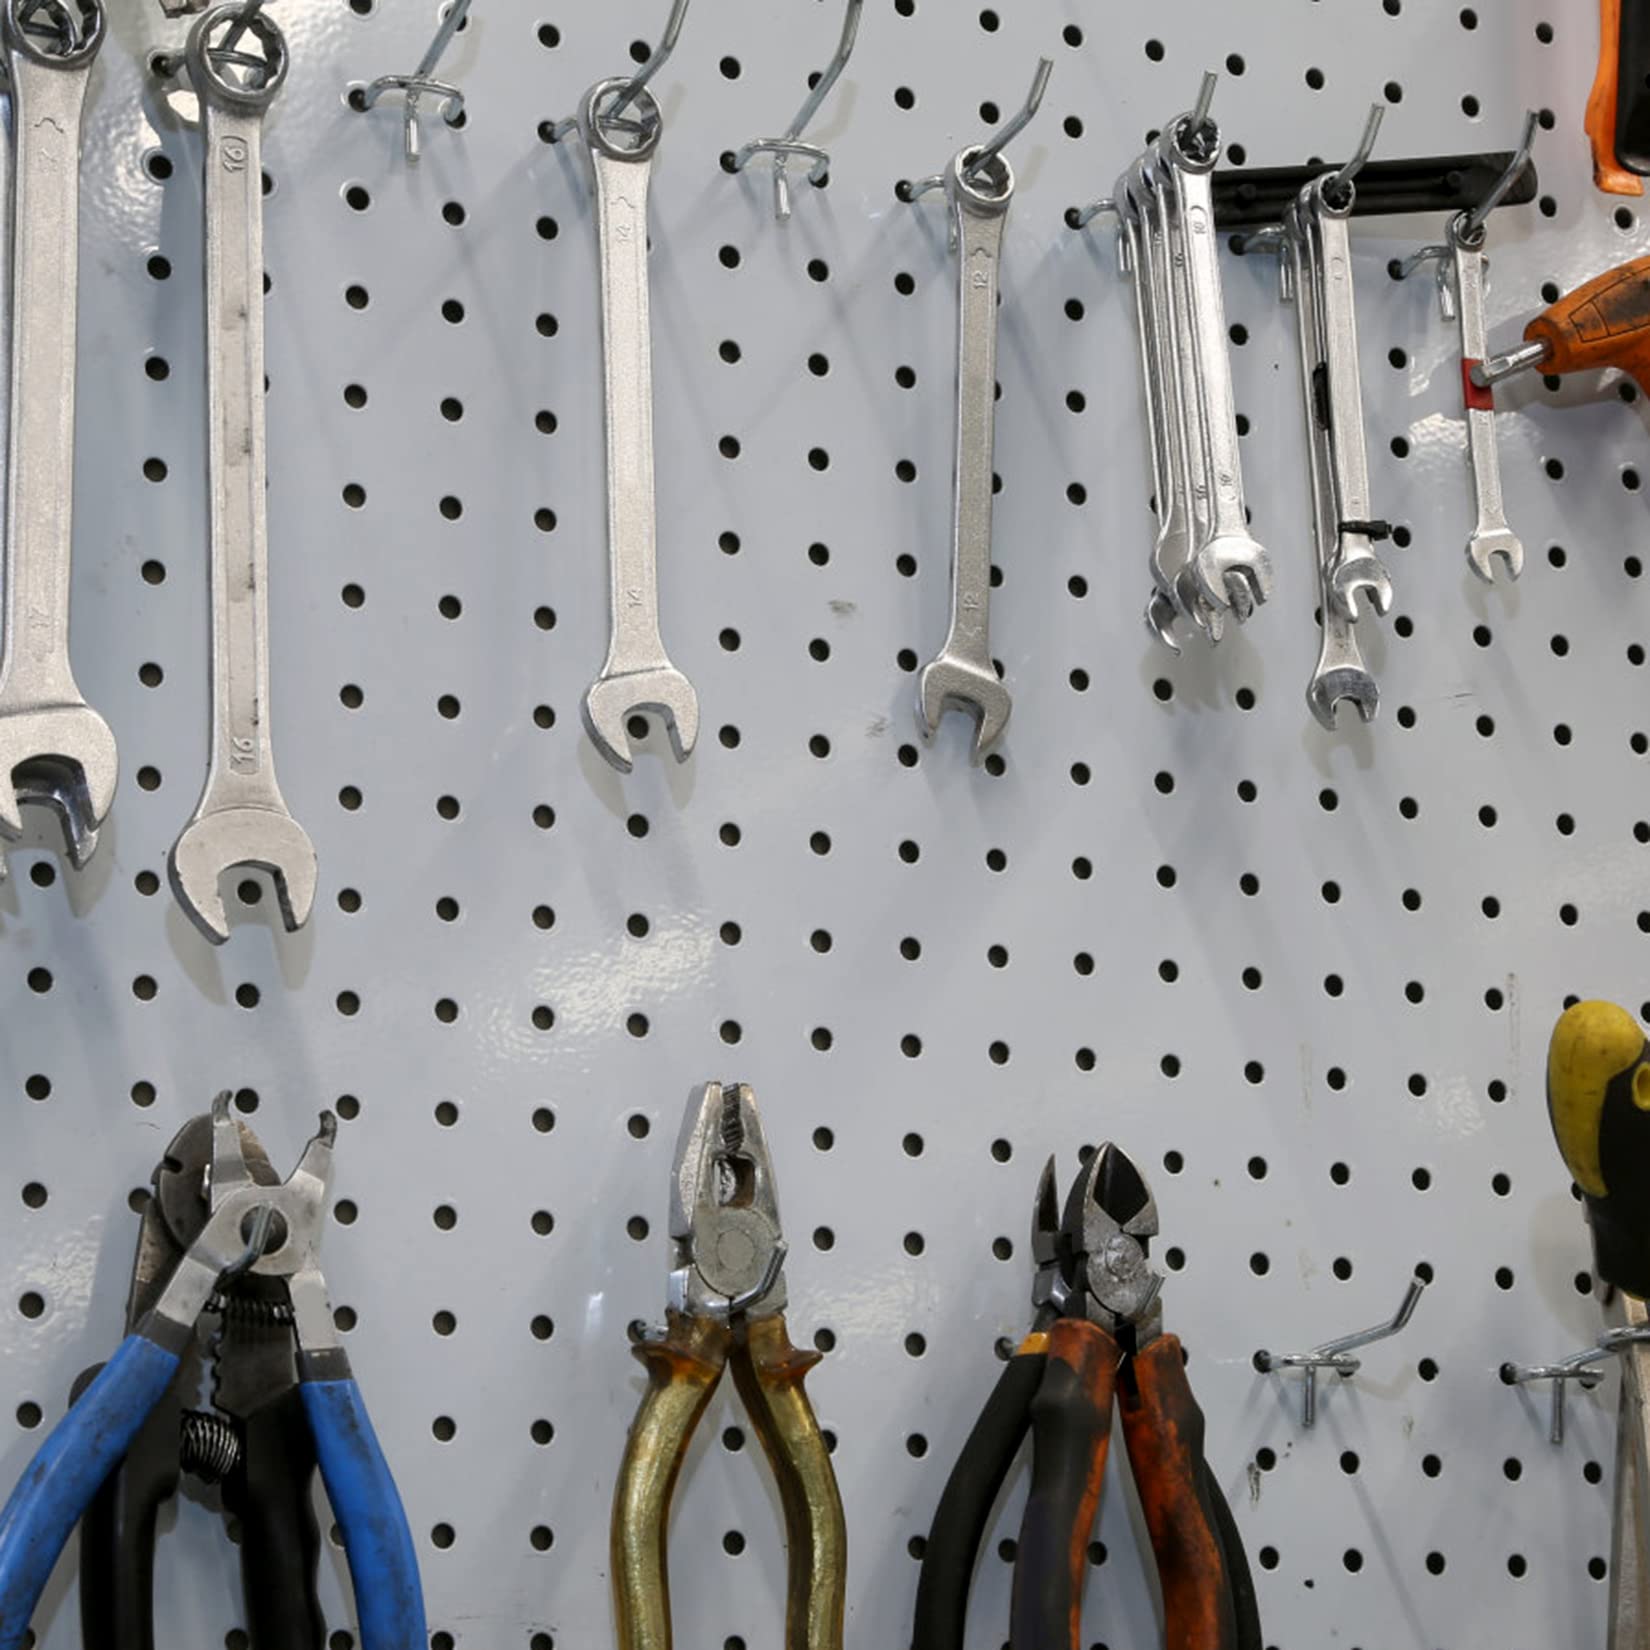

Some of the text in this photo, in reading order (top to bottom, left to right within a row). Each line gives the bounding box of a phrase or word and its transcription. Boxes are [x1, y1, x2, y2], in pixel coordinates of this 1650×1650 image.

[222, 146, 246, 173] 16
[972, 269, 989, 289] 12
[963, 592, 979, 611] 12
[230, 736, 256, 765] 16
